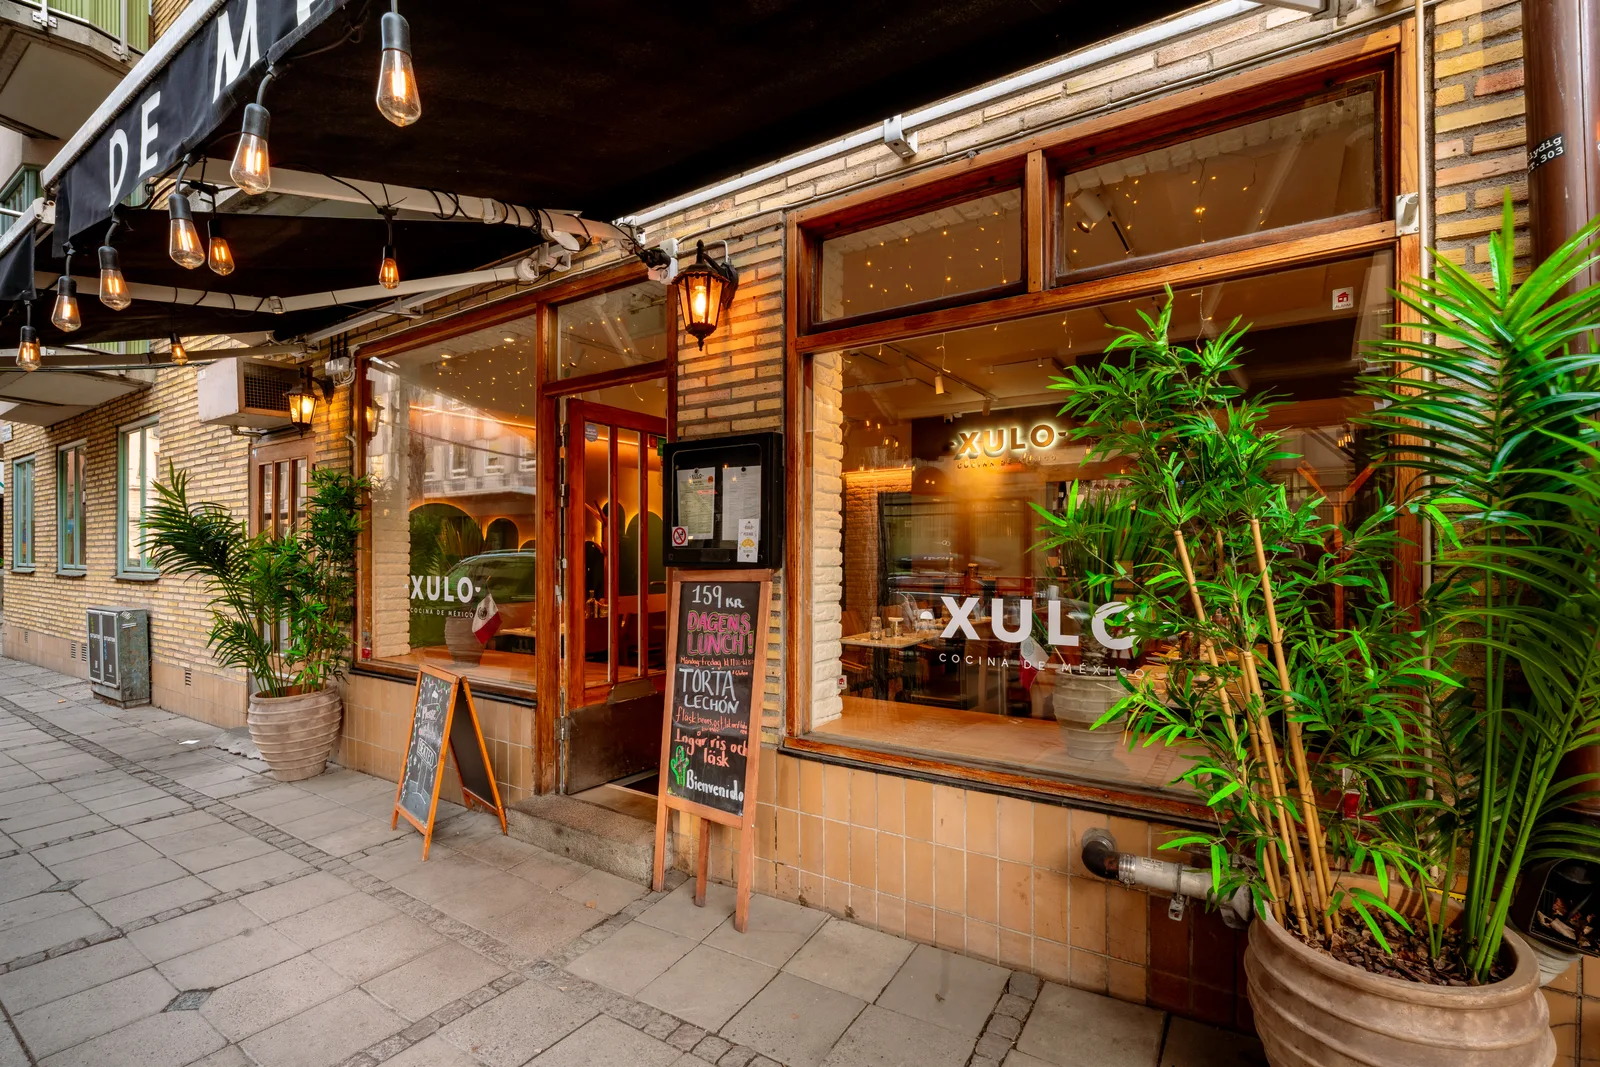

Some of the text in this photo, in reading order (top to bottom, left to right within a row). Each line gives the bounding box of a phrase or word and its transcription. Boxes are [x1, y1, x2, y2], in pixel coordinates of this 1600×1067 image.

[109, 90, 161, 208] DE
[956, 424, 1055, 458] XULO
[410, 575, 474, 603] XULO
[691, 584, 723, 609] 159
[410, 607, 434, 615] COCINA
[448, 610, 474, 618] MÉXICO
[687, 610, 751, 635] DAGENS
[940, 596, 1142, 650] XULO
[687, 630, 755, 655] LUNCH!
[939, 653, 1145, 679] COCINA DE MÉXICO
[679, 667, 737, 701] TORTA
[684, 694, 740, 714] LECHÓN
[710, 735, 727, 751] ris
[703, 747, 730, 768] läsk
[686, 769, 744, 802] Bienvenido
